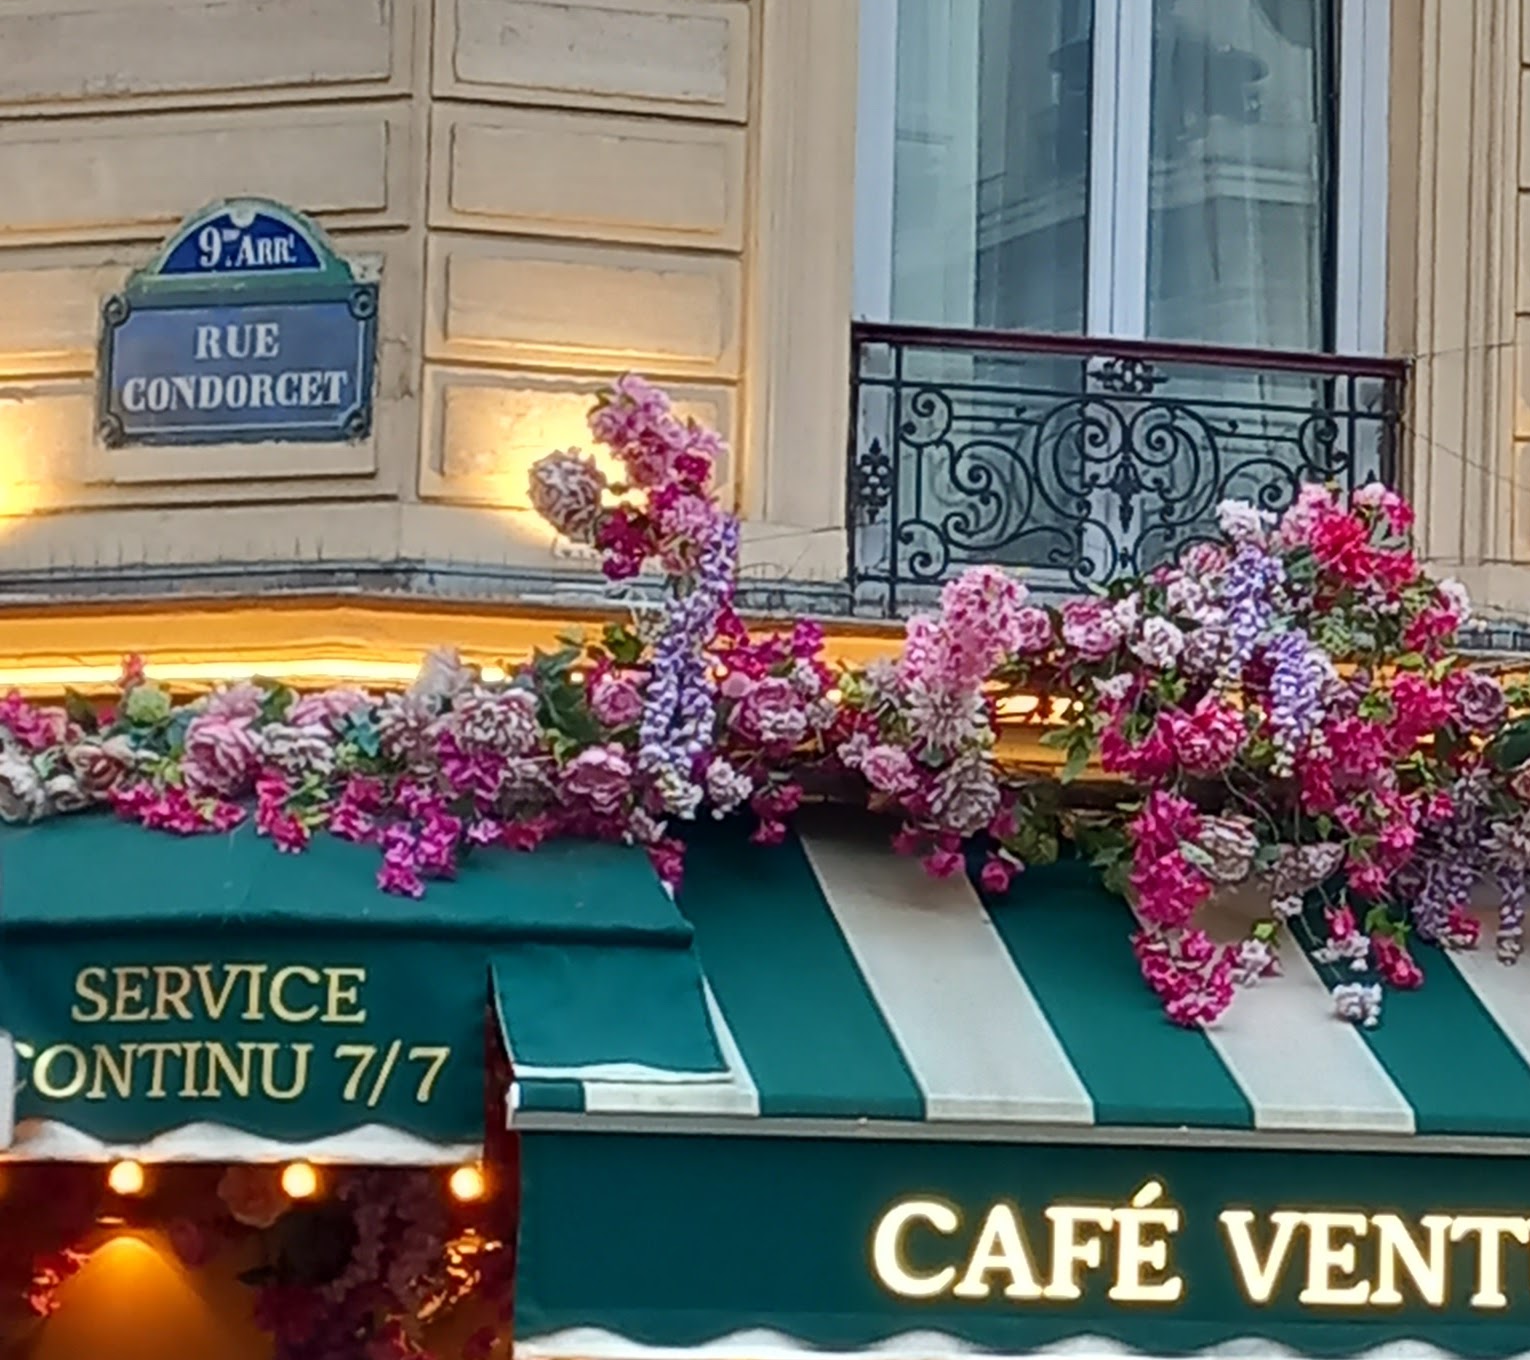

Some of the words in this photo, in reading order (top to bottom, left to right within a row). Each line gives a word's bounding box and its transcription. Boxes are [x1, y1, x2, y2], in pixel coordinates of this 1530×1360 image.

[194, 322, 280, 360] RUE
[122, 370, 348, 412] CONDORCET
[71, 964, 367, 1023] SERVICE
[14, 1040, 310, 1099] ONTINU
[333, 1038, 451, 1108] 7/7
[873, 1180, 1184, 1301] CAFÉ
